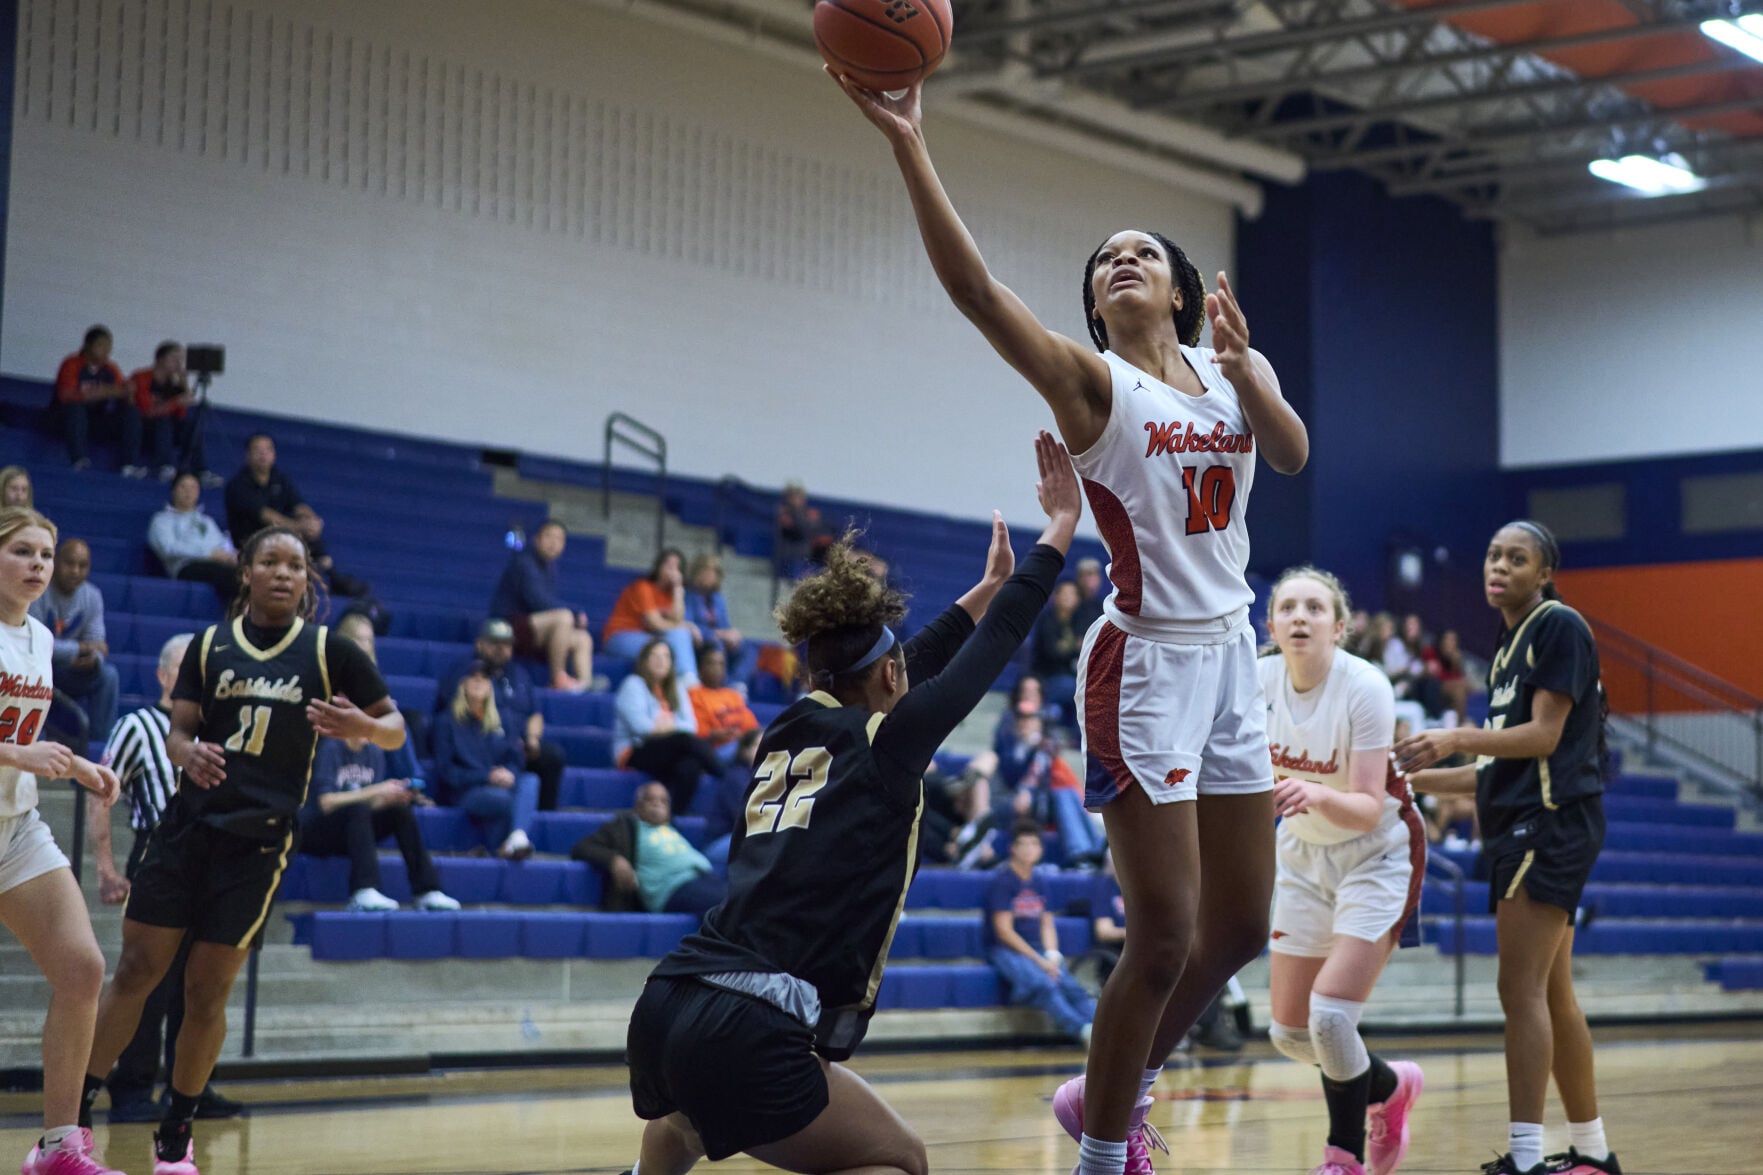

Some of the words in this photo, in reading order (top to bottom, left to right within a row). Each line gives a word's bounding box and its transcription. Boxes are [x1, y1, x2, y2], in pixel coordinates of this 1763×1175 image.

[1182, 465, 1236, 536] 10
[0, 671, 53, 701] Wakelan
[215, 668, 303, 704] Eastside
[0, 706, 43, 746] 24
[225, 705, 272, 756] 11
[745, 746, 834, 837] 22
